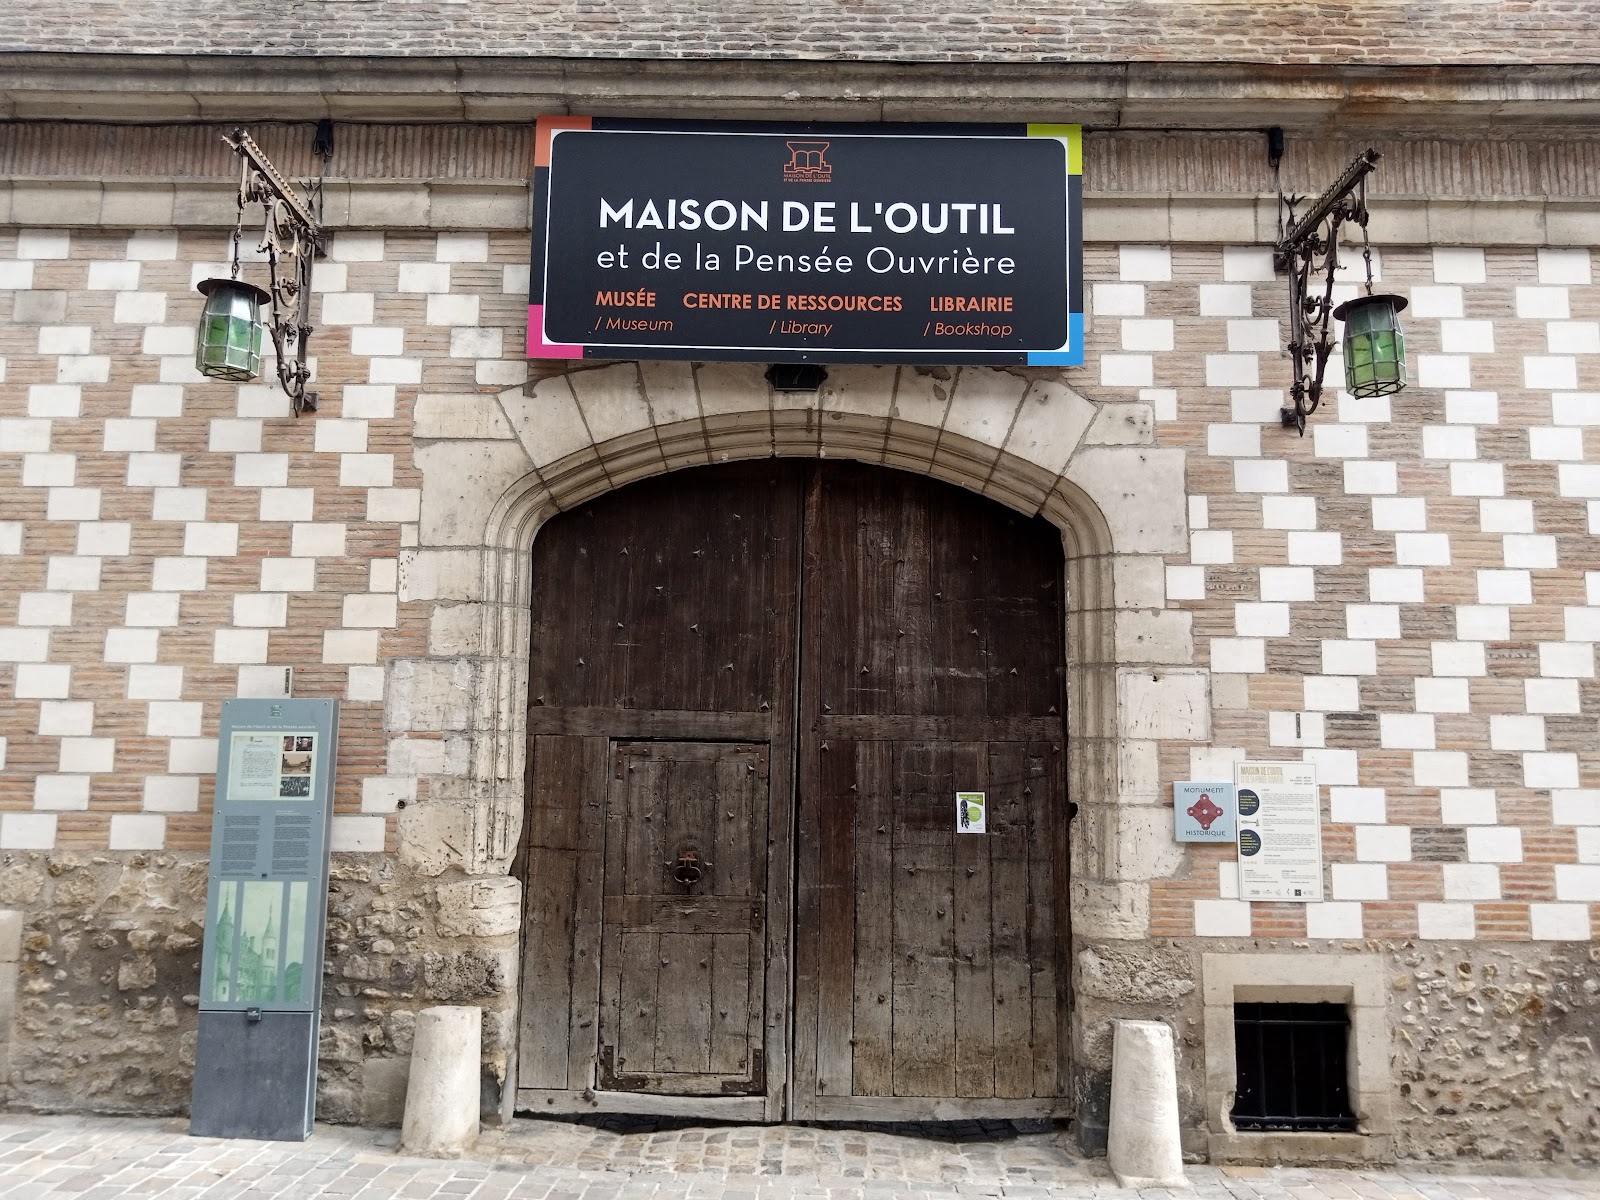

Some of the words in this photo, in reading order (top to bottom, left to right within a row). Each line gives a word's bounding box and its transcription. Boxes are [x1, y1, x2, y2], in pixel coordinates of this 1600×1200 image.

[599, 197, 769, 232] MAISON
[782, 200, 836, 233] DE
[850, 201, 1015, 235] L'OUTIL
[596, 244, 629, 269] et
[641, 242, 682, 270] de
[695, 243, 720, 271] la
[735, 244, 853, 274] Pensée
[866, 246, 1016, 275] Ouvrière
[595, 288, 656, 308] MUSÉE
[682, 293, 752, 310] CENTRE
[757, 294, 781, 310] DE
[787, 294, 903, 312] RESSOURCES
[930, 297, 1013, 312] LIBRAIRIE
[605, 317, 674, 331] Museum
[780, 320, 833, 338] Library
[934, 322, 1013, 339] Bookshop
